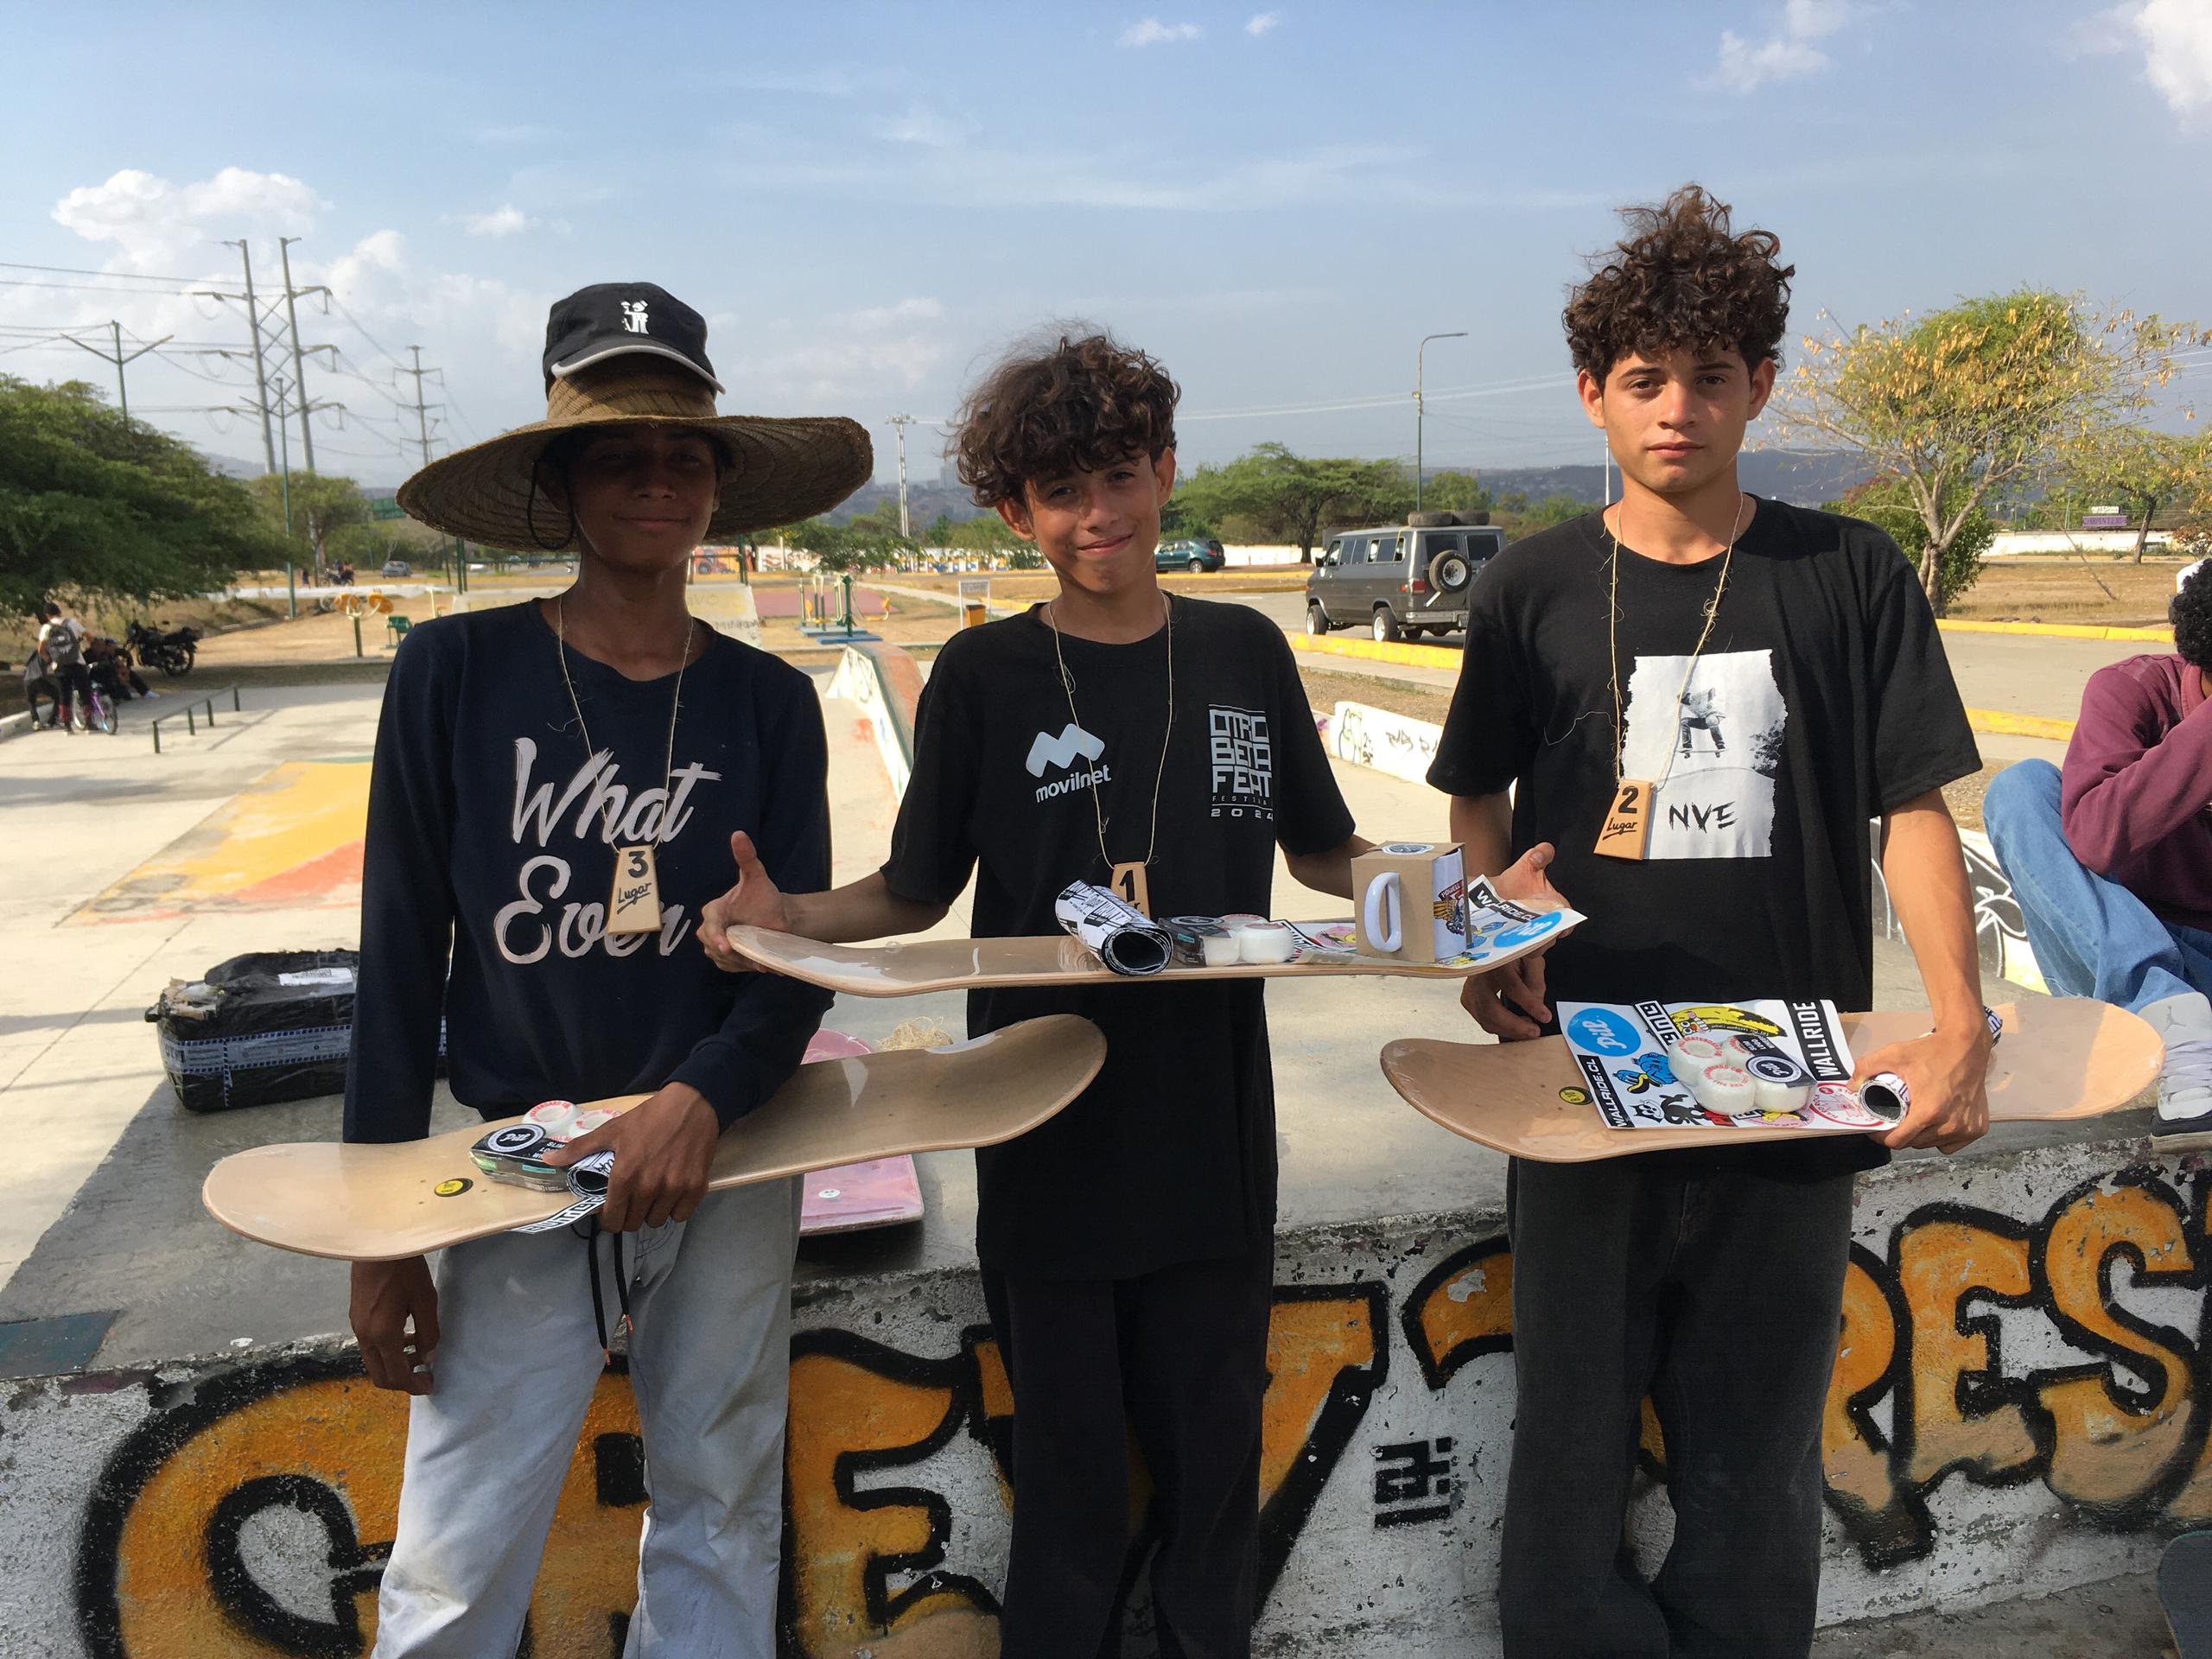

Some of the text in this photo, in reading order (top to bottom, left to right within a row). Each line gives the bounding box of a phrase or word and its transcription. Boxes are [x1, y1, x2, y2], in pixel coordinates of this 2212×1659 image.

[1211, 737, 1272, 772] BETA
[512, 736, 722, 848] What
[1035, 764, 1112, 804] movilnet
[1618, 785, 1639, 814] 2
[1211, 808, 1274, 823] 2024
[1605, 817, 1638, 838] Lugar
[1669, 801, 1738, 835] NVE
[627, 850, 648, 879] 3
[617, 881, 652, 905] Lugar
[1119, 869, 1135, 902] 1
[1792, 1001, 1841, 1077] WALLRIDE
[1586, 1058, 1628, 1127] WALLRIDE.CL
